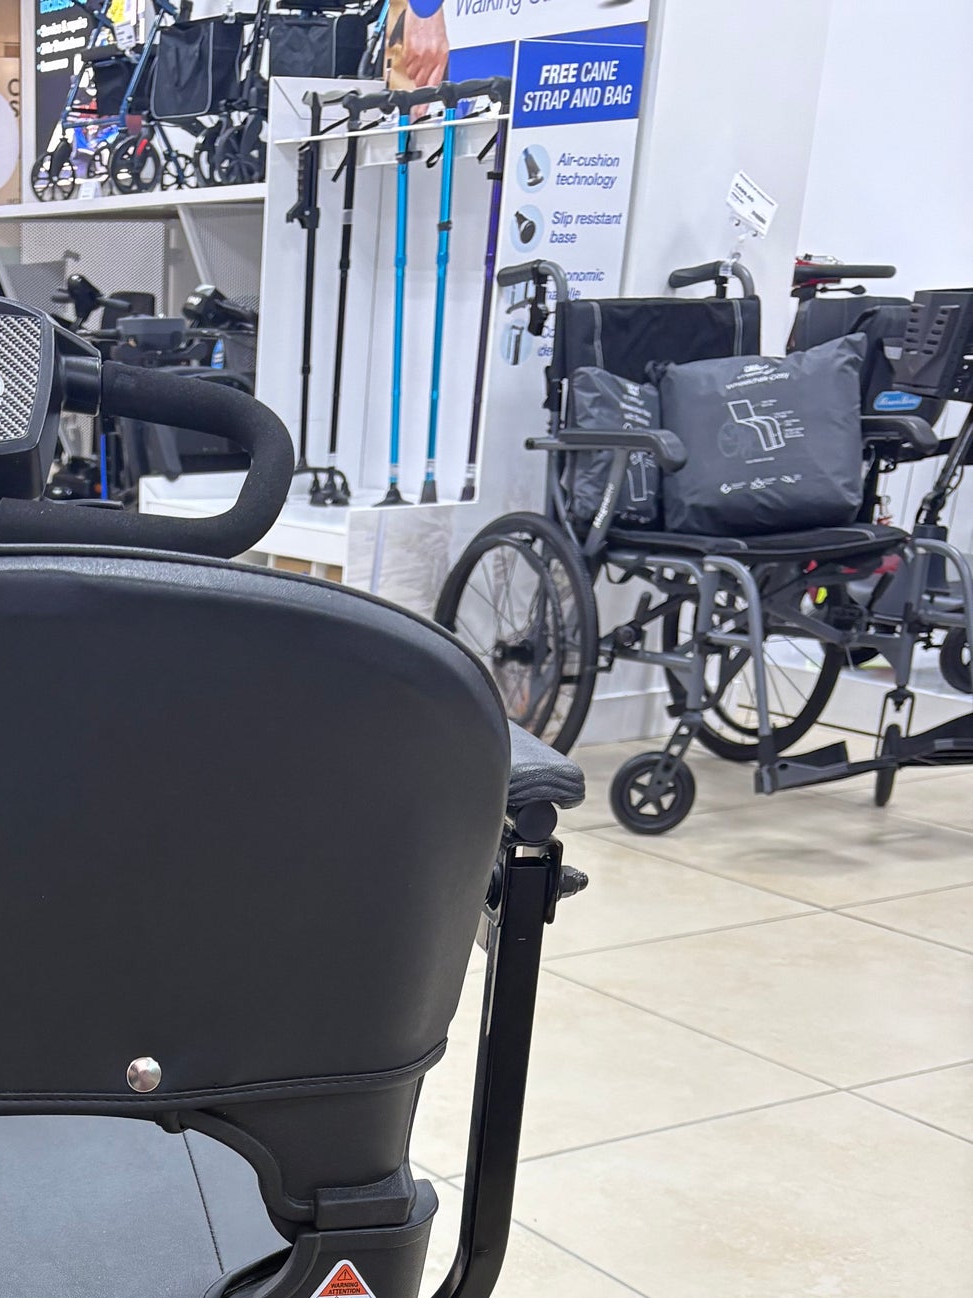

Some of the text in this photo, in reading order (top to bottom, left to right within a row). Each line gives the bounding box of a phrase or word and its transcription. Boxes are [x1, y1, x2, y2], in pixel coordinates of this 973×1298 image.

[539, 60, 619, 86] FREE CANE
[522, 84, 633, 112] STRAP AND BAG
[556, 153, 620, 167] Air-cushion
[555, 172, 617, 189] technology
[551, 211, 623, 228] Slip resistant
[549, 230, 577, 244] base
